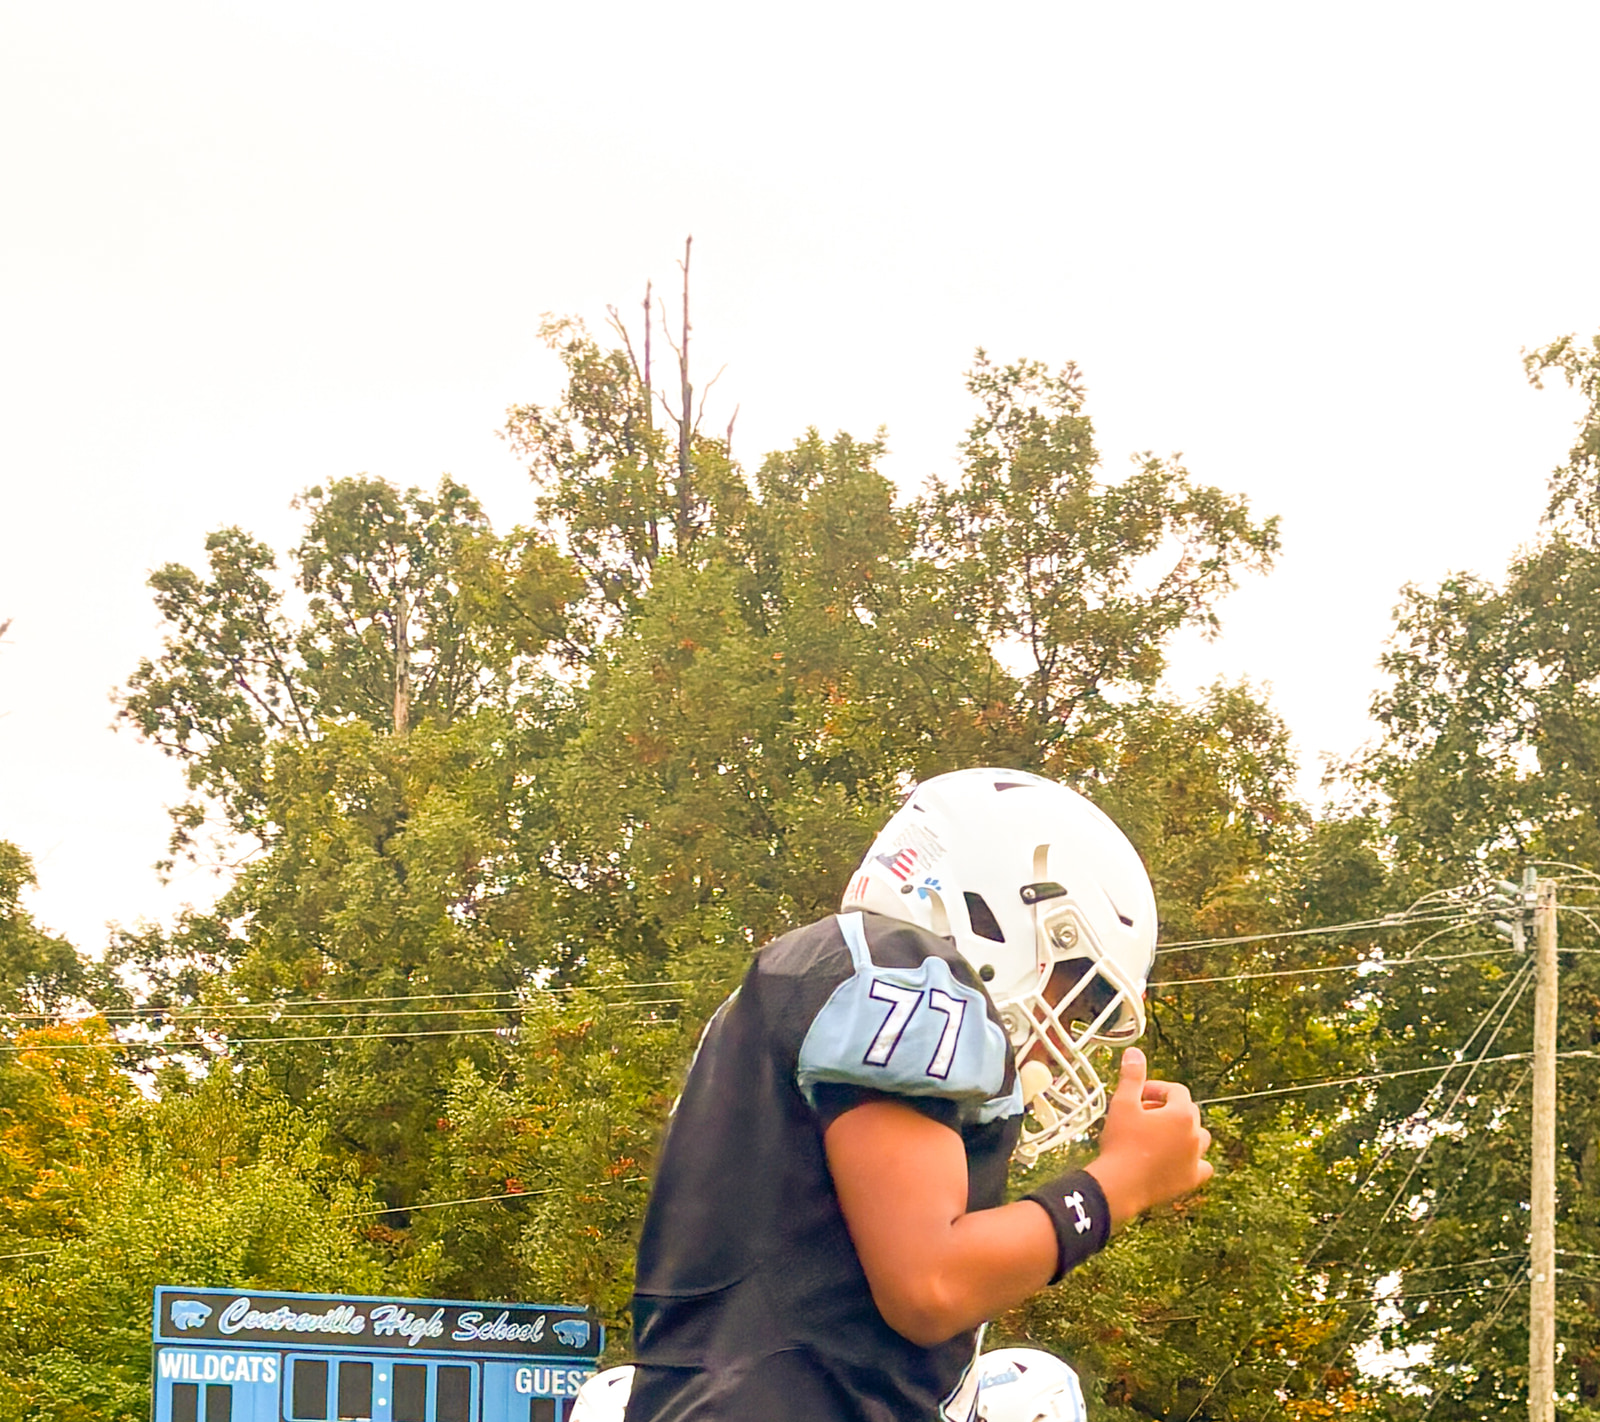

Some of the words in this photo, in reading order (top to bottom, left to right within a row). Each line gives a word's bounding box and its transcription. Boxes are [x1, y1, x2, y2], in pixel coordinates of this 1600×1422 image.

[863, 979, 967, 1080] 77
[218, 1297, 365, 1334] Centreville
[370, 1305, 445, 1346] High
[451, 1311, 546, 1342] School
[159, 1352, 277, 1383] WILDCATS
